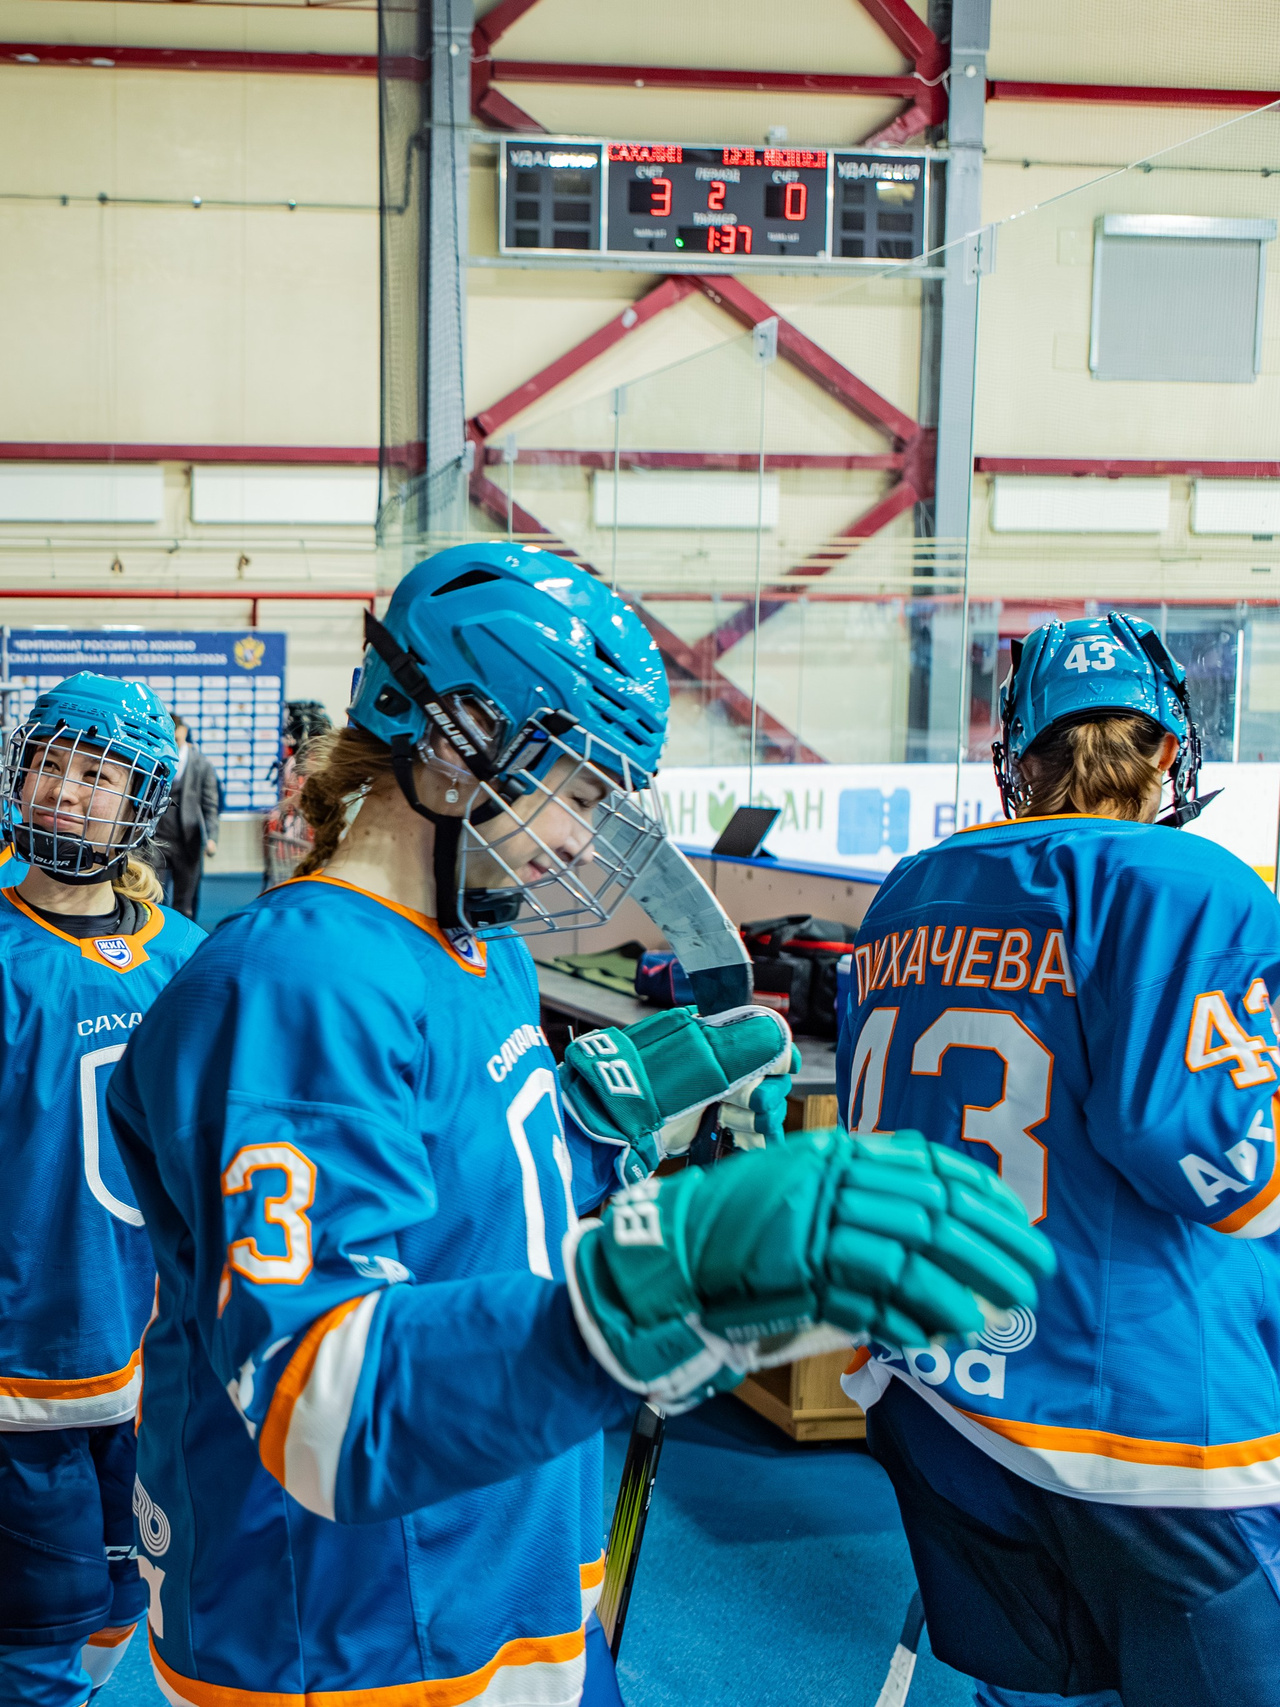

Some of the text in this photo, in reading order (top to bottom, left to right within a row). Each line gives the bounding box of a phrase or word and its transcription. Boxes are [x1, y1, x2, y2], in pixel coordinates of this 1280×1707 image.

[509, 149, 598, 169] УДАЛ
[650, 178, 672, 217] 3
[708, 181, 726, 210] 2
[784, 182, 807, 221] 0
[707, 225, 752, 254] 1:37
[108, 653, 135, 665] ЛИГА
[131, 640, 148, 651] ПО
[1064, 641, 1116, 674] 43
[424, 701, 478, 757] BAUER
[77, 1012, 143, 1037] САХА
[848, 1006, 1054, 1226] 43
[219, 1141, 317, 1300] 3
